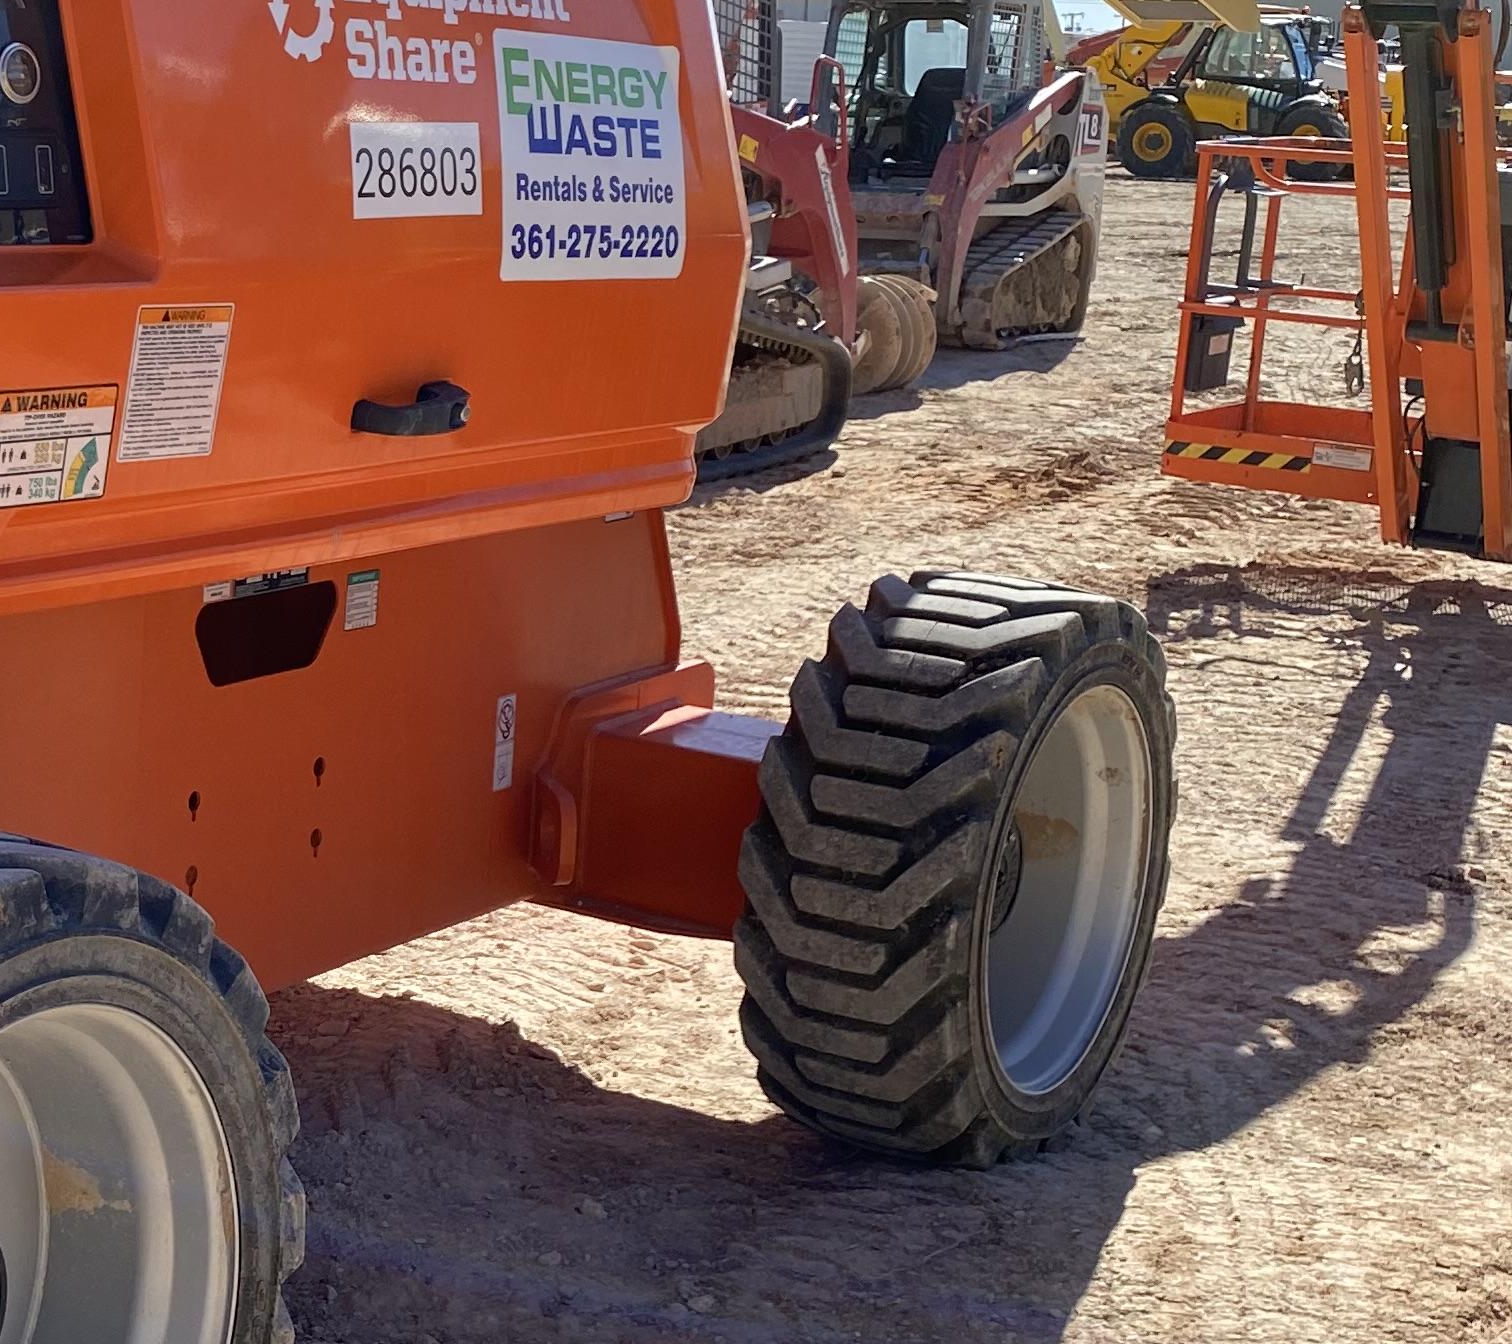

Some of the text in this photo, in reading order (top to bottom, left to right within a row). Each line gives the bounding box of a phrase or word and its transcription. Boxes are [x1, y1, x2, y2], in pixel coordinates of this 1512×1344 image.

[345, 18, 477, 84] Share
[502, 47, 668, 116] ENERGY
[527, 103, 662, 159] WASTE
[354, 147, 477, 199] 286803
[515, 172, 674, 205] Rentals & Service
[511, 223, 679, 258] 361-275-2220
[170, 309, 206, 321] WARNING
[16, 392, 88, 412] WARNING
[28, 487, 56, 499] 340 kg
[29, 476, 57, 488] 750 lbs
